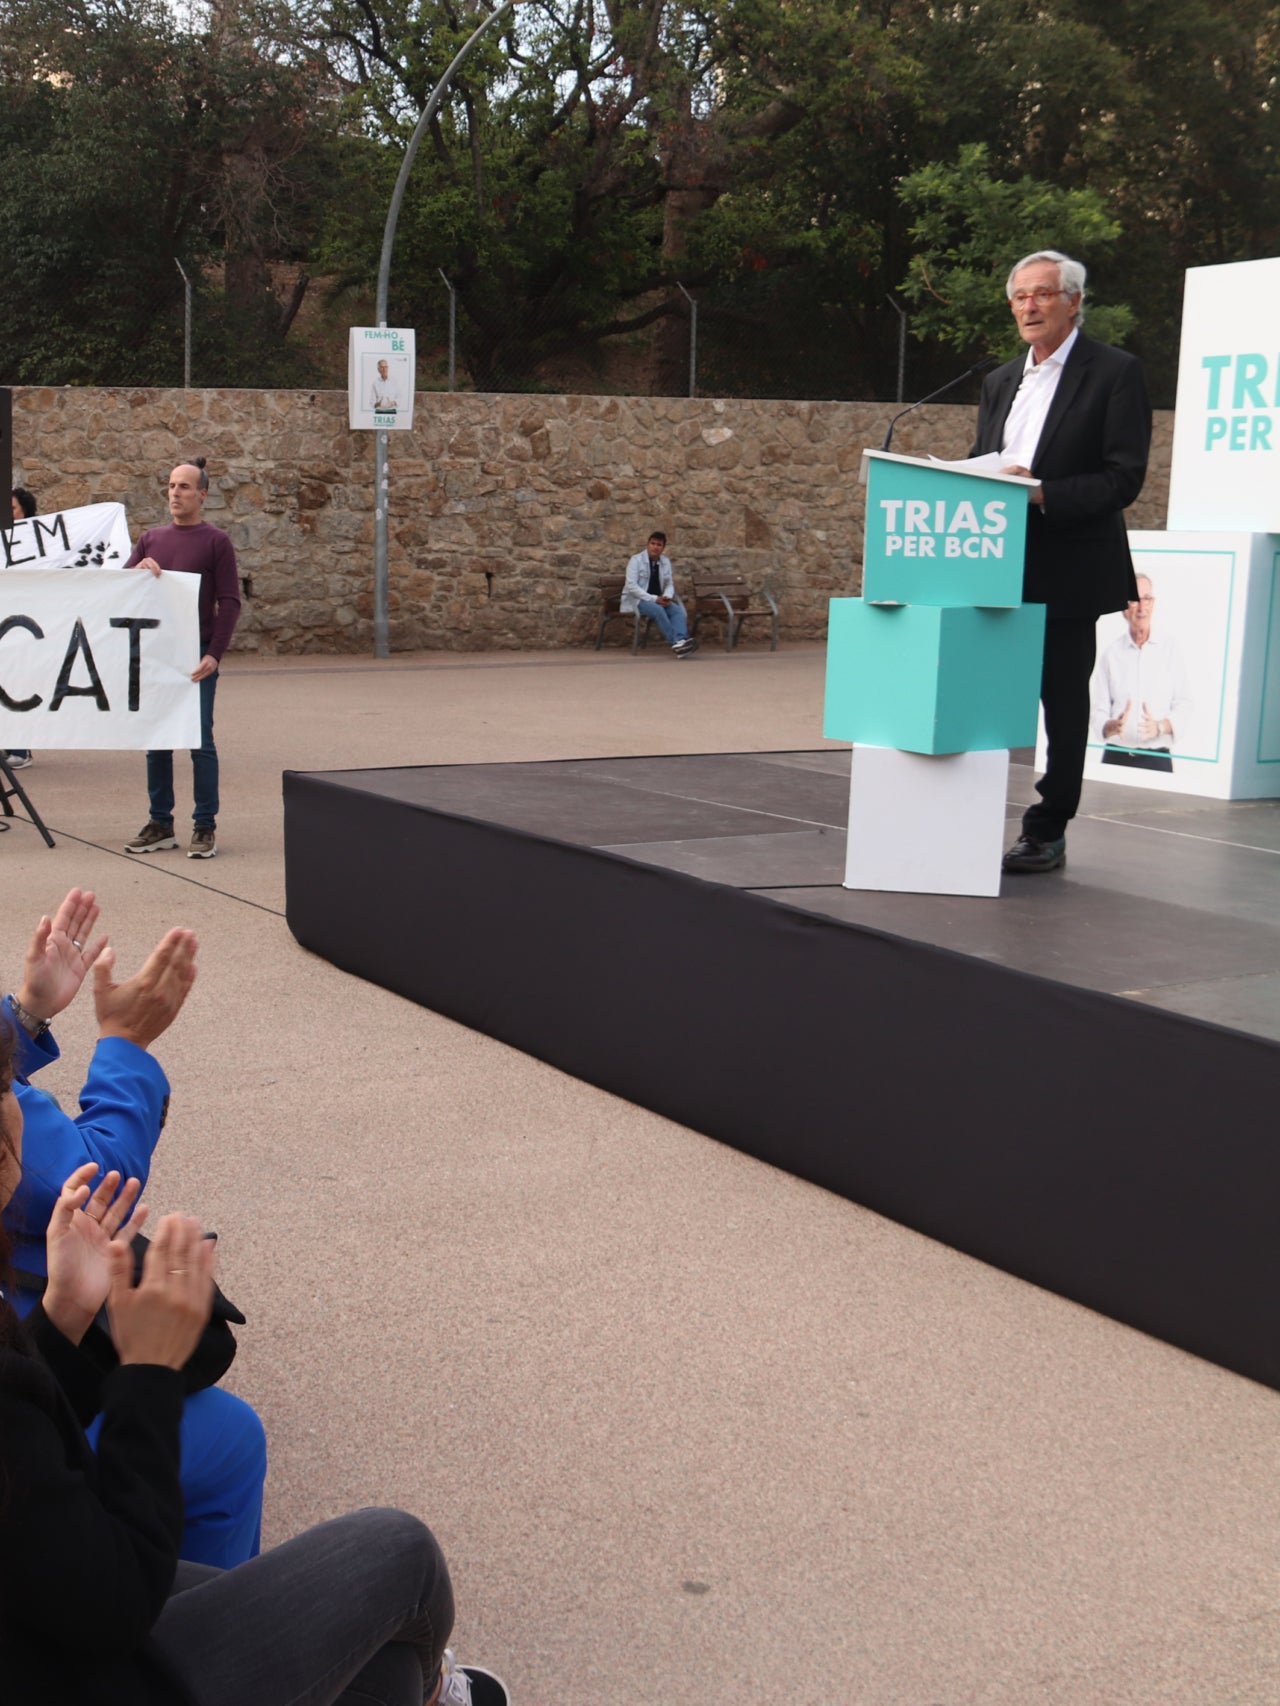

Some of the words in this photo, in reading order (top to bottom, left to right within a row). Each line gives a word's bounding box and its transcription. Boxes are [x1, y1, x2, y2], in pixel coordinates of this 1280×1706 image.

[364, 330, 398, 340] FEM-HO
[373, 416, 396, 424] TRIAS
[1205, 415, 1273, 451] PER
[880, 500, 1007, 535] TRIAS
[885, 535, 936, 557] PER
[944, 536, 1004, 558] BCN
